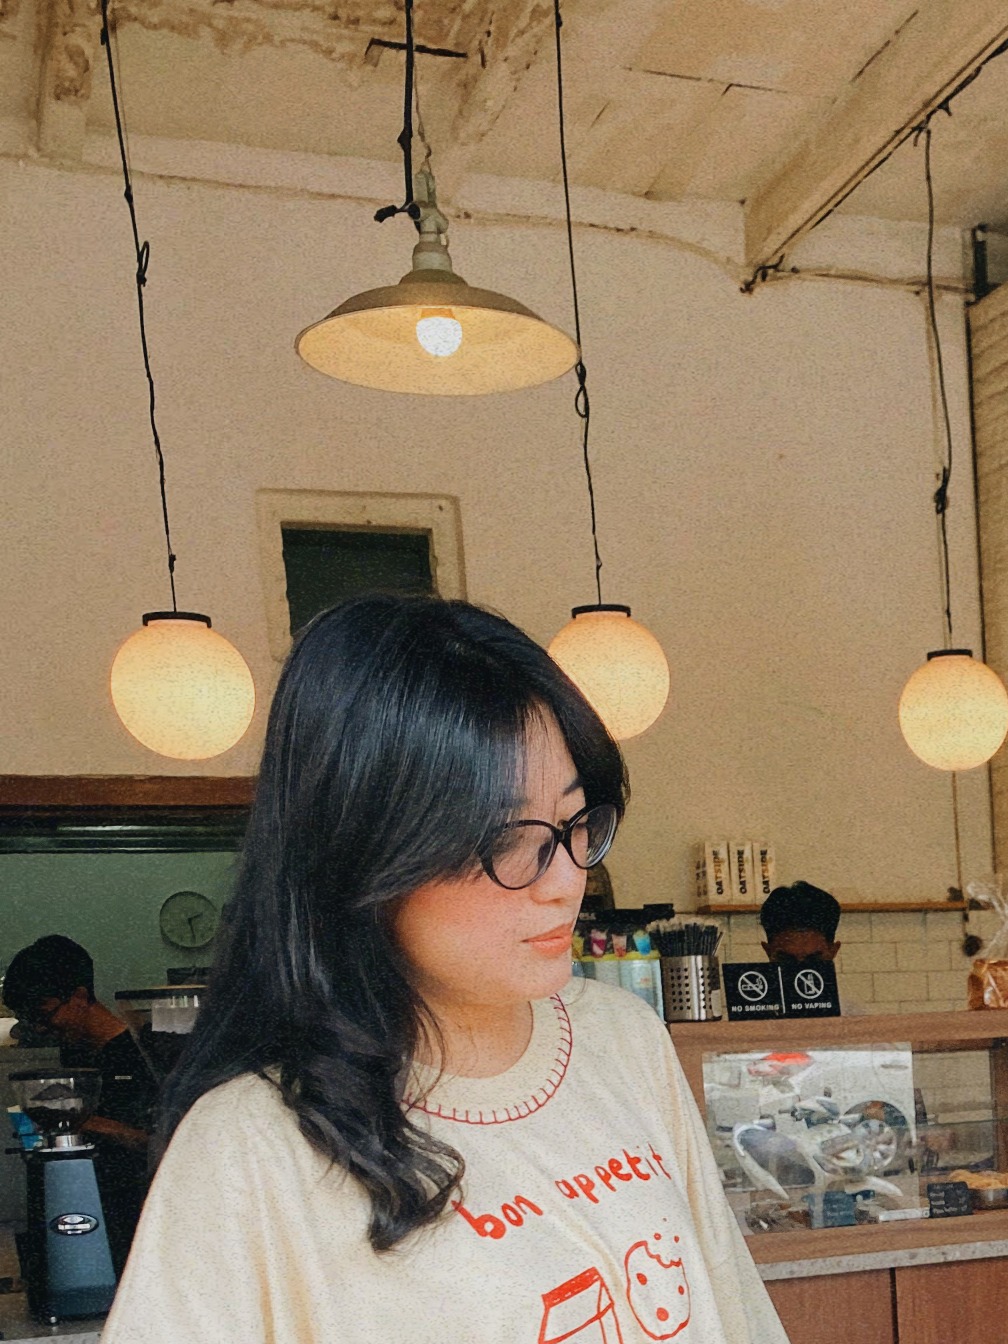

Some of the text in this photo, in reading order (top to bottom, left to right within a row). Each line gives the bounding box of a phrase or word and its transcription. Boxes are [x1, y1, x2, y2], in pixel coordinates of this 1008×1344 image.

[712, 849, 725, 895] OATSIDE
[736, 849, 748, 895] OATSIDE
[759, 849, 771, 894] OATSIDE
[731, 1003, 780, 1012] NO SMOKING
[791, 1001, 832, 1010] NO VAPING
[451, 1141, 672, 1240] bon appetit
